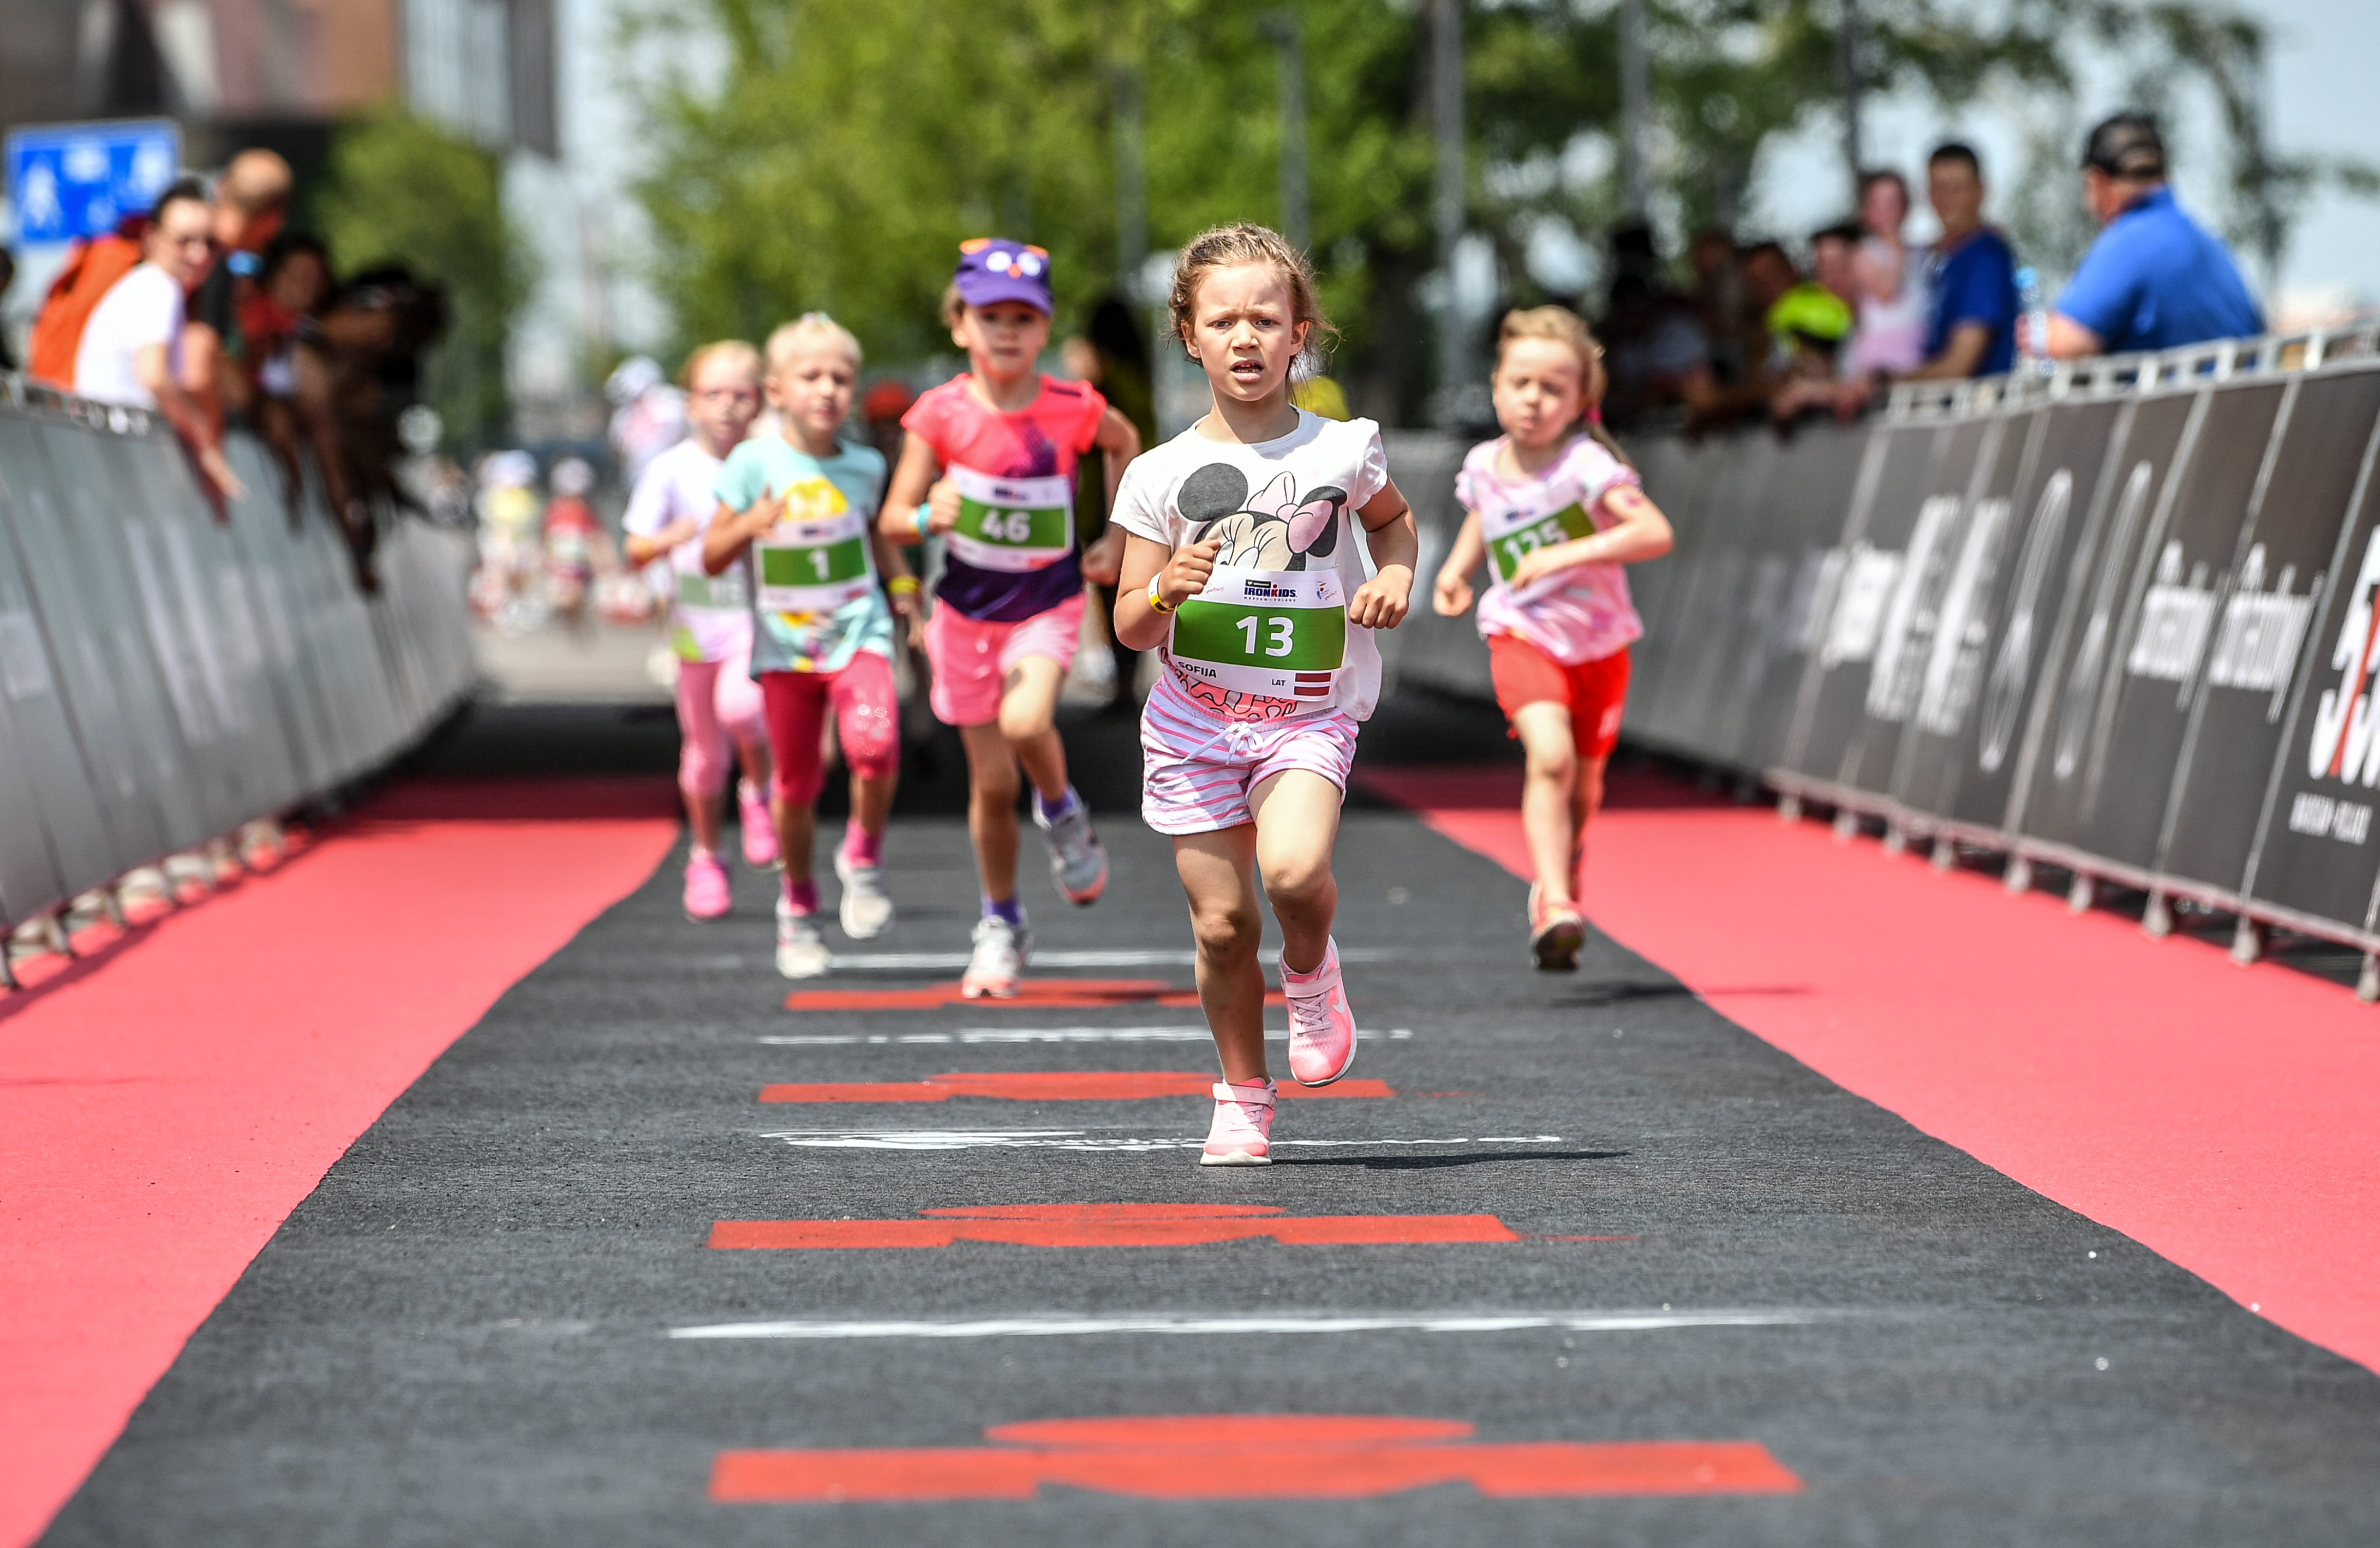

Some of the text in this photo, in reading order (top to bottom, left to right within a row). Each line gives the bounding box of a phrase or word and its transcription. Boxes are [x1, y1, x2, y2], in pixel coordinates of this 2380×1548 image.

[981, 508, 1031, 543] 46
[808, 549, 830, 583] 1
[1244, 584, 1296, 598] IRONKIDS
[1236, 616, 1294, 657] 13
[1177, 661, 1217, 678] SOFIJA
